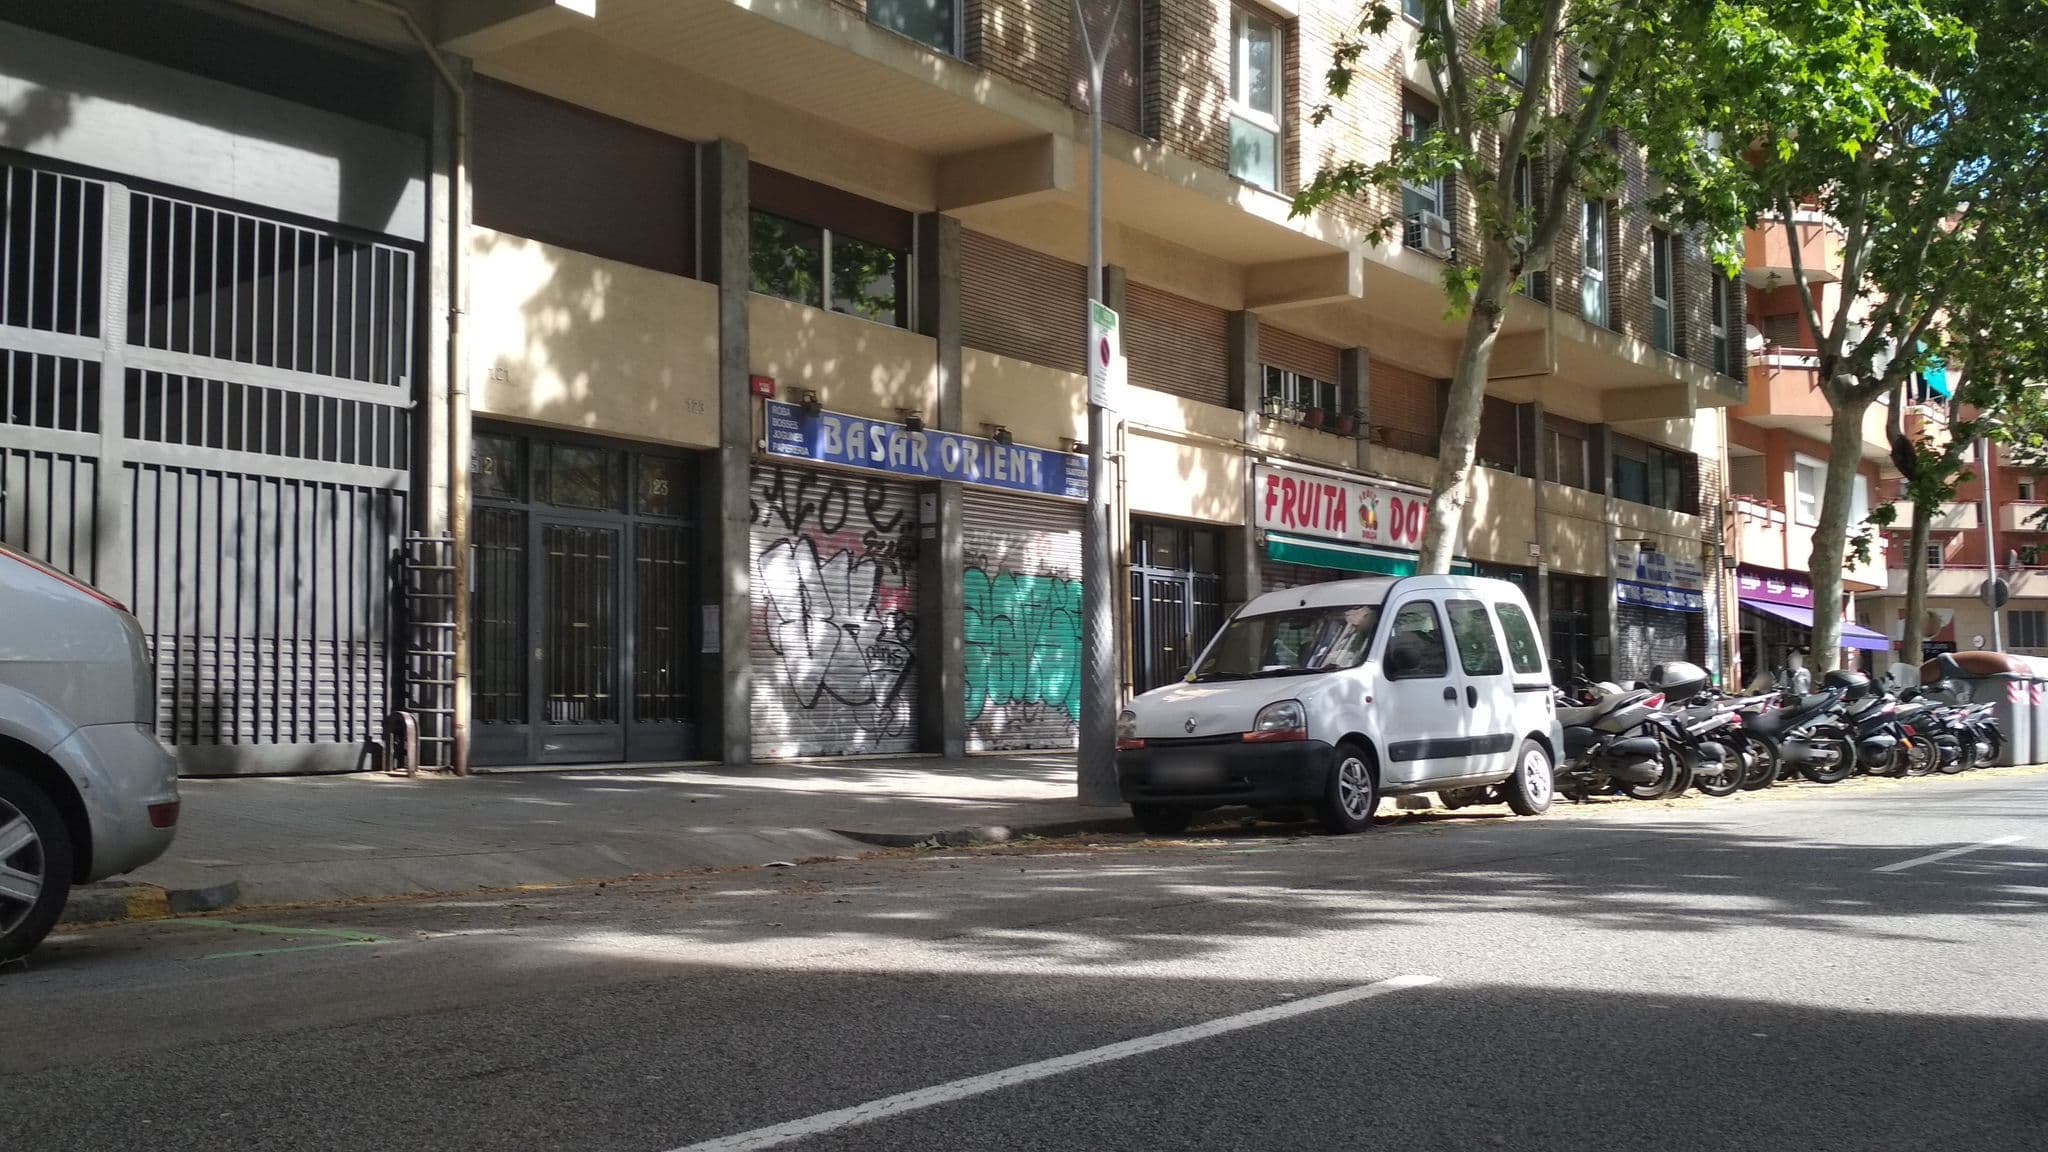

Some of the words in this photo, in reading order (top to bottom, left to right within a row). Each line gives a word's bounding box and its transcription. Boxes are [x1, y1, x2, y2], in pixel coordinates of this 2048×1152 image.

[771, 417, 800, 430] BOSSES
[822, 416, 929, 473] BASAR
[940, 436, 1043, 486] ORIENT
[1264, 473, 1347, 534] FRUITA
[1389, 496, 1429, 545] DO
